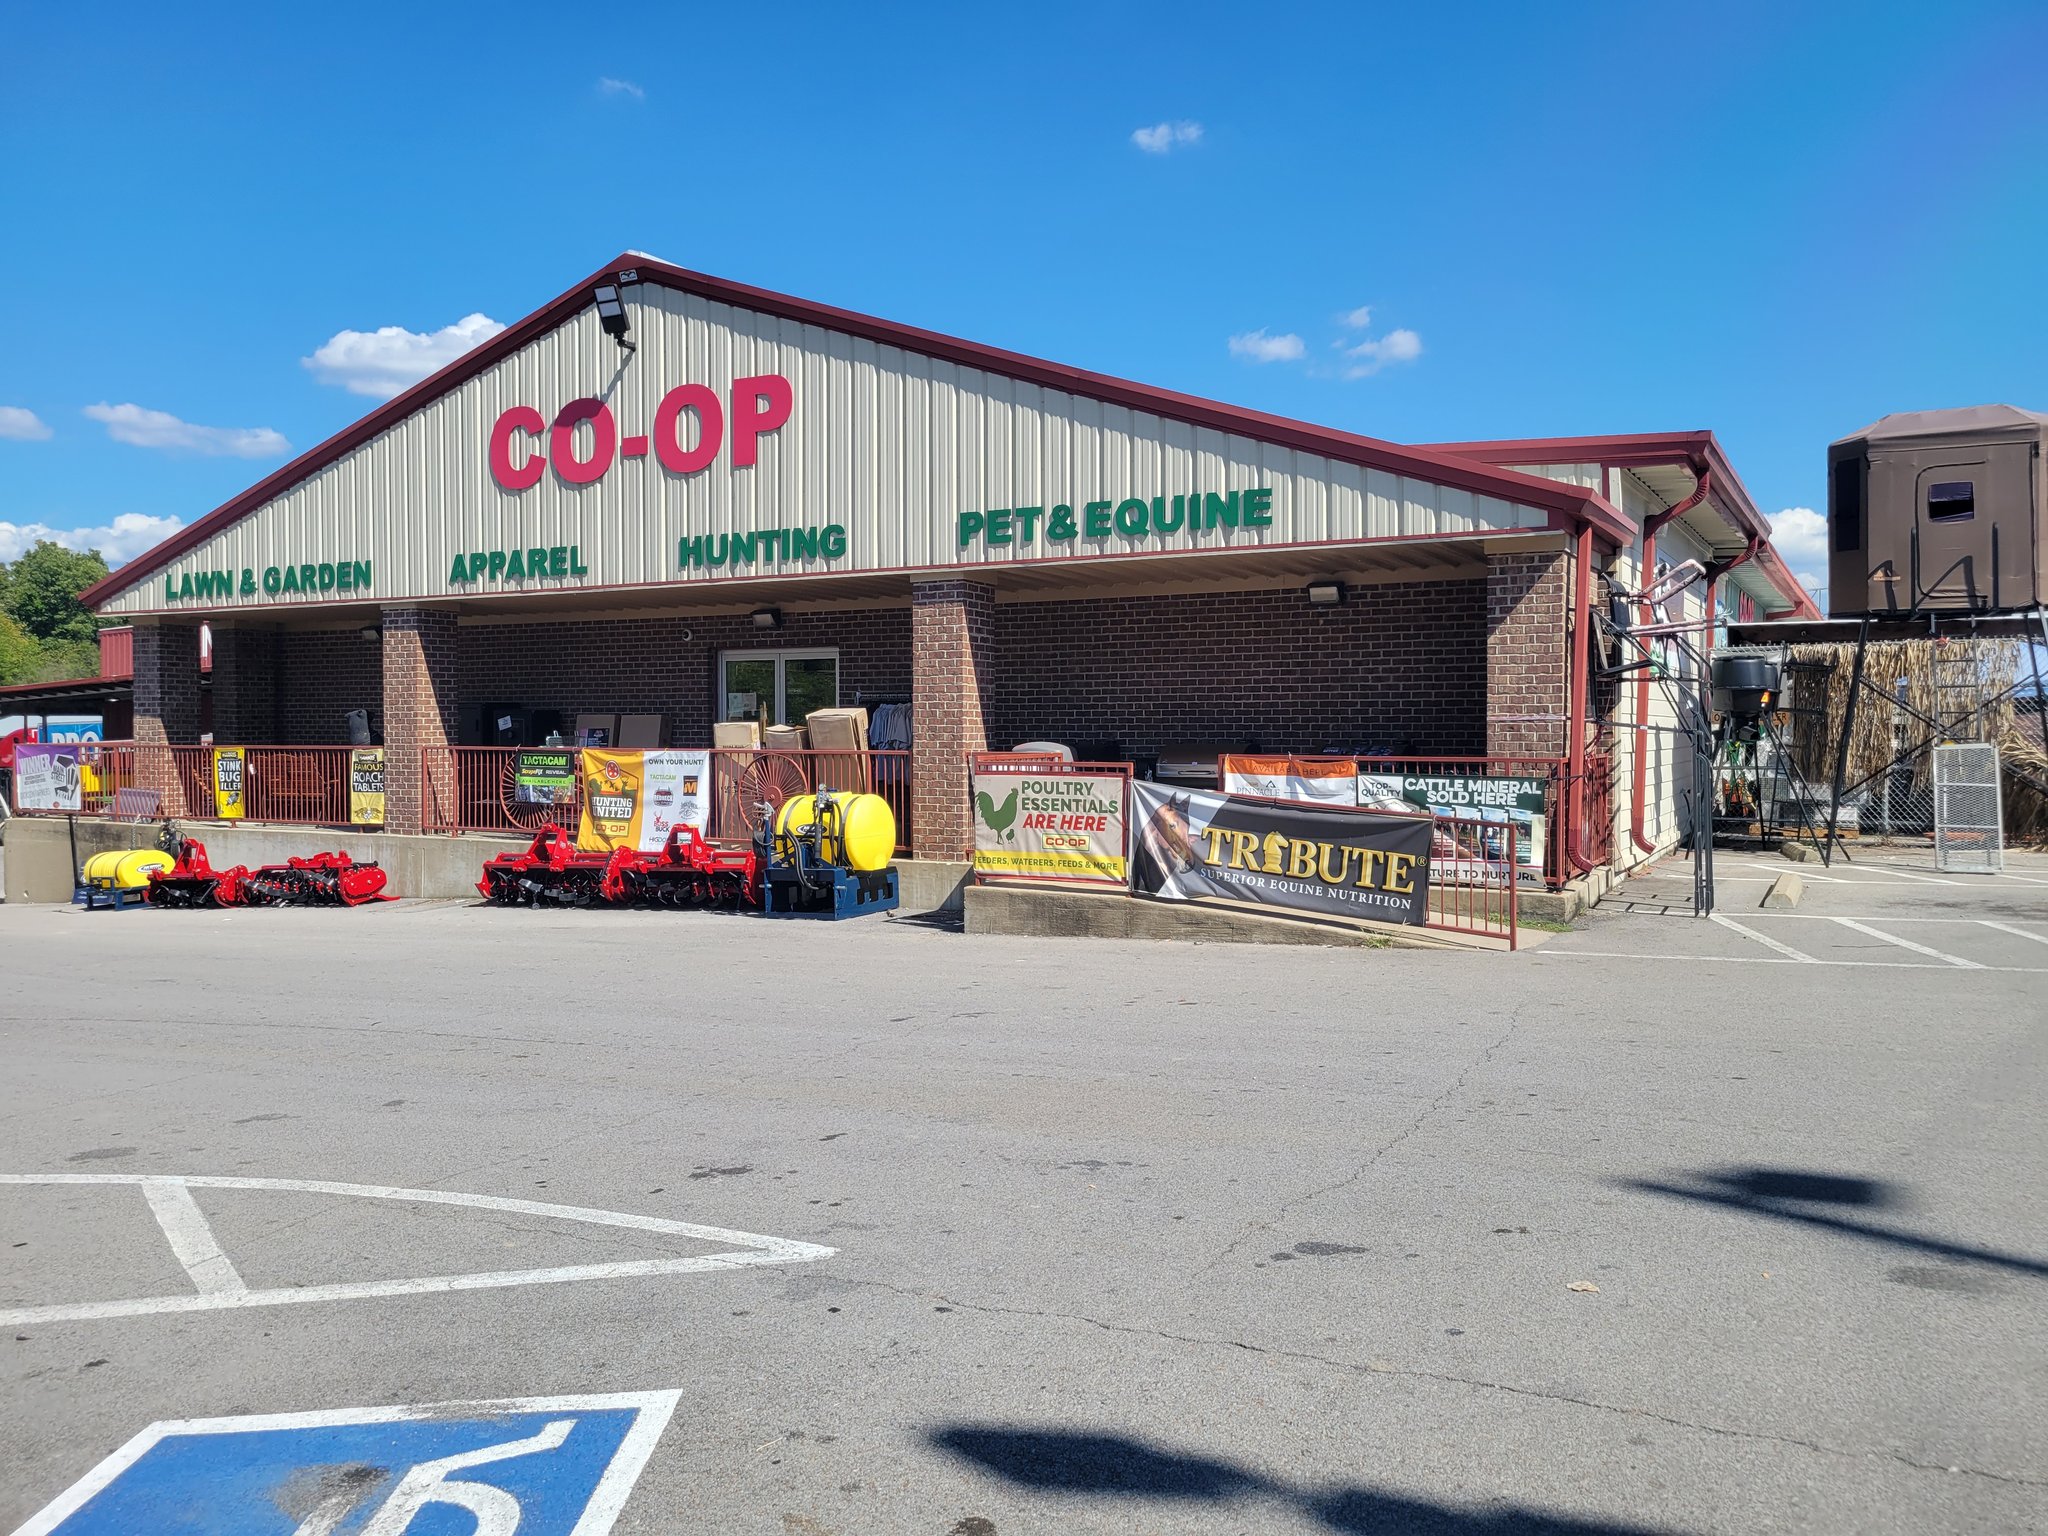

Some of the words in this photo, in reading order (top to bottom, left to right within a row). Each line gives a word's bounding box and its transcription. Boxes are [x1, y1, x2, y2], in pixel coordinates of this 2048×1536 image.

[490, 374, 793, 490] CO-OP
[680, 524, 846, 567] HUNTING
[449, 545, 588, 582] APPAREL
[166, 569, 233, 599] LAWN
[240, 568, 258, 594] &
[263, 560, 372, 593] GARDEN
[218, 760, 241, 771] STINK
[522, 755, 567, 766] TACTACAM
[354, 763, 383, 771] FAMOUS
[219, 771, 241, 782] BUG
[353, 771, 384, 782] ROACH
[220, 782, 242, 790] ILLER
[353, 782, 384, 792] TABLETS
[1021, 781, 1094, 796] POULTRY
[1404, 778, 1464, 792] CATTLE
[1468, 779, 1542, 795] MINERAL
[1362, 788, 1401, 798] QUALITY
[1426, 791, 1470, 804] SOLD
[1473, 792, 1518, 806] HERE
[591, 796, 633, 808] HUNTING
[1021, 797, 1119, 815] ESSENTIALS
[592, 806, 632, 818] UNITED
[1022, 813, 1057, 829] ARE
[1059, 814, 1108, 832] HERE
[1058, 860, 1083, 868] FEEDS
[1093, 861, 1118, 871] MORE
[1463, 869, 1479, 878] TO
[1200, 867, 1266, 888] SUPERIOR
[1269, 879, 1324, 897] EQUINE
[1327, 888, 1412, 910] NUTRITION
